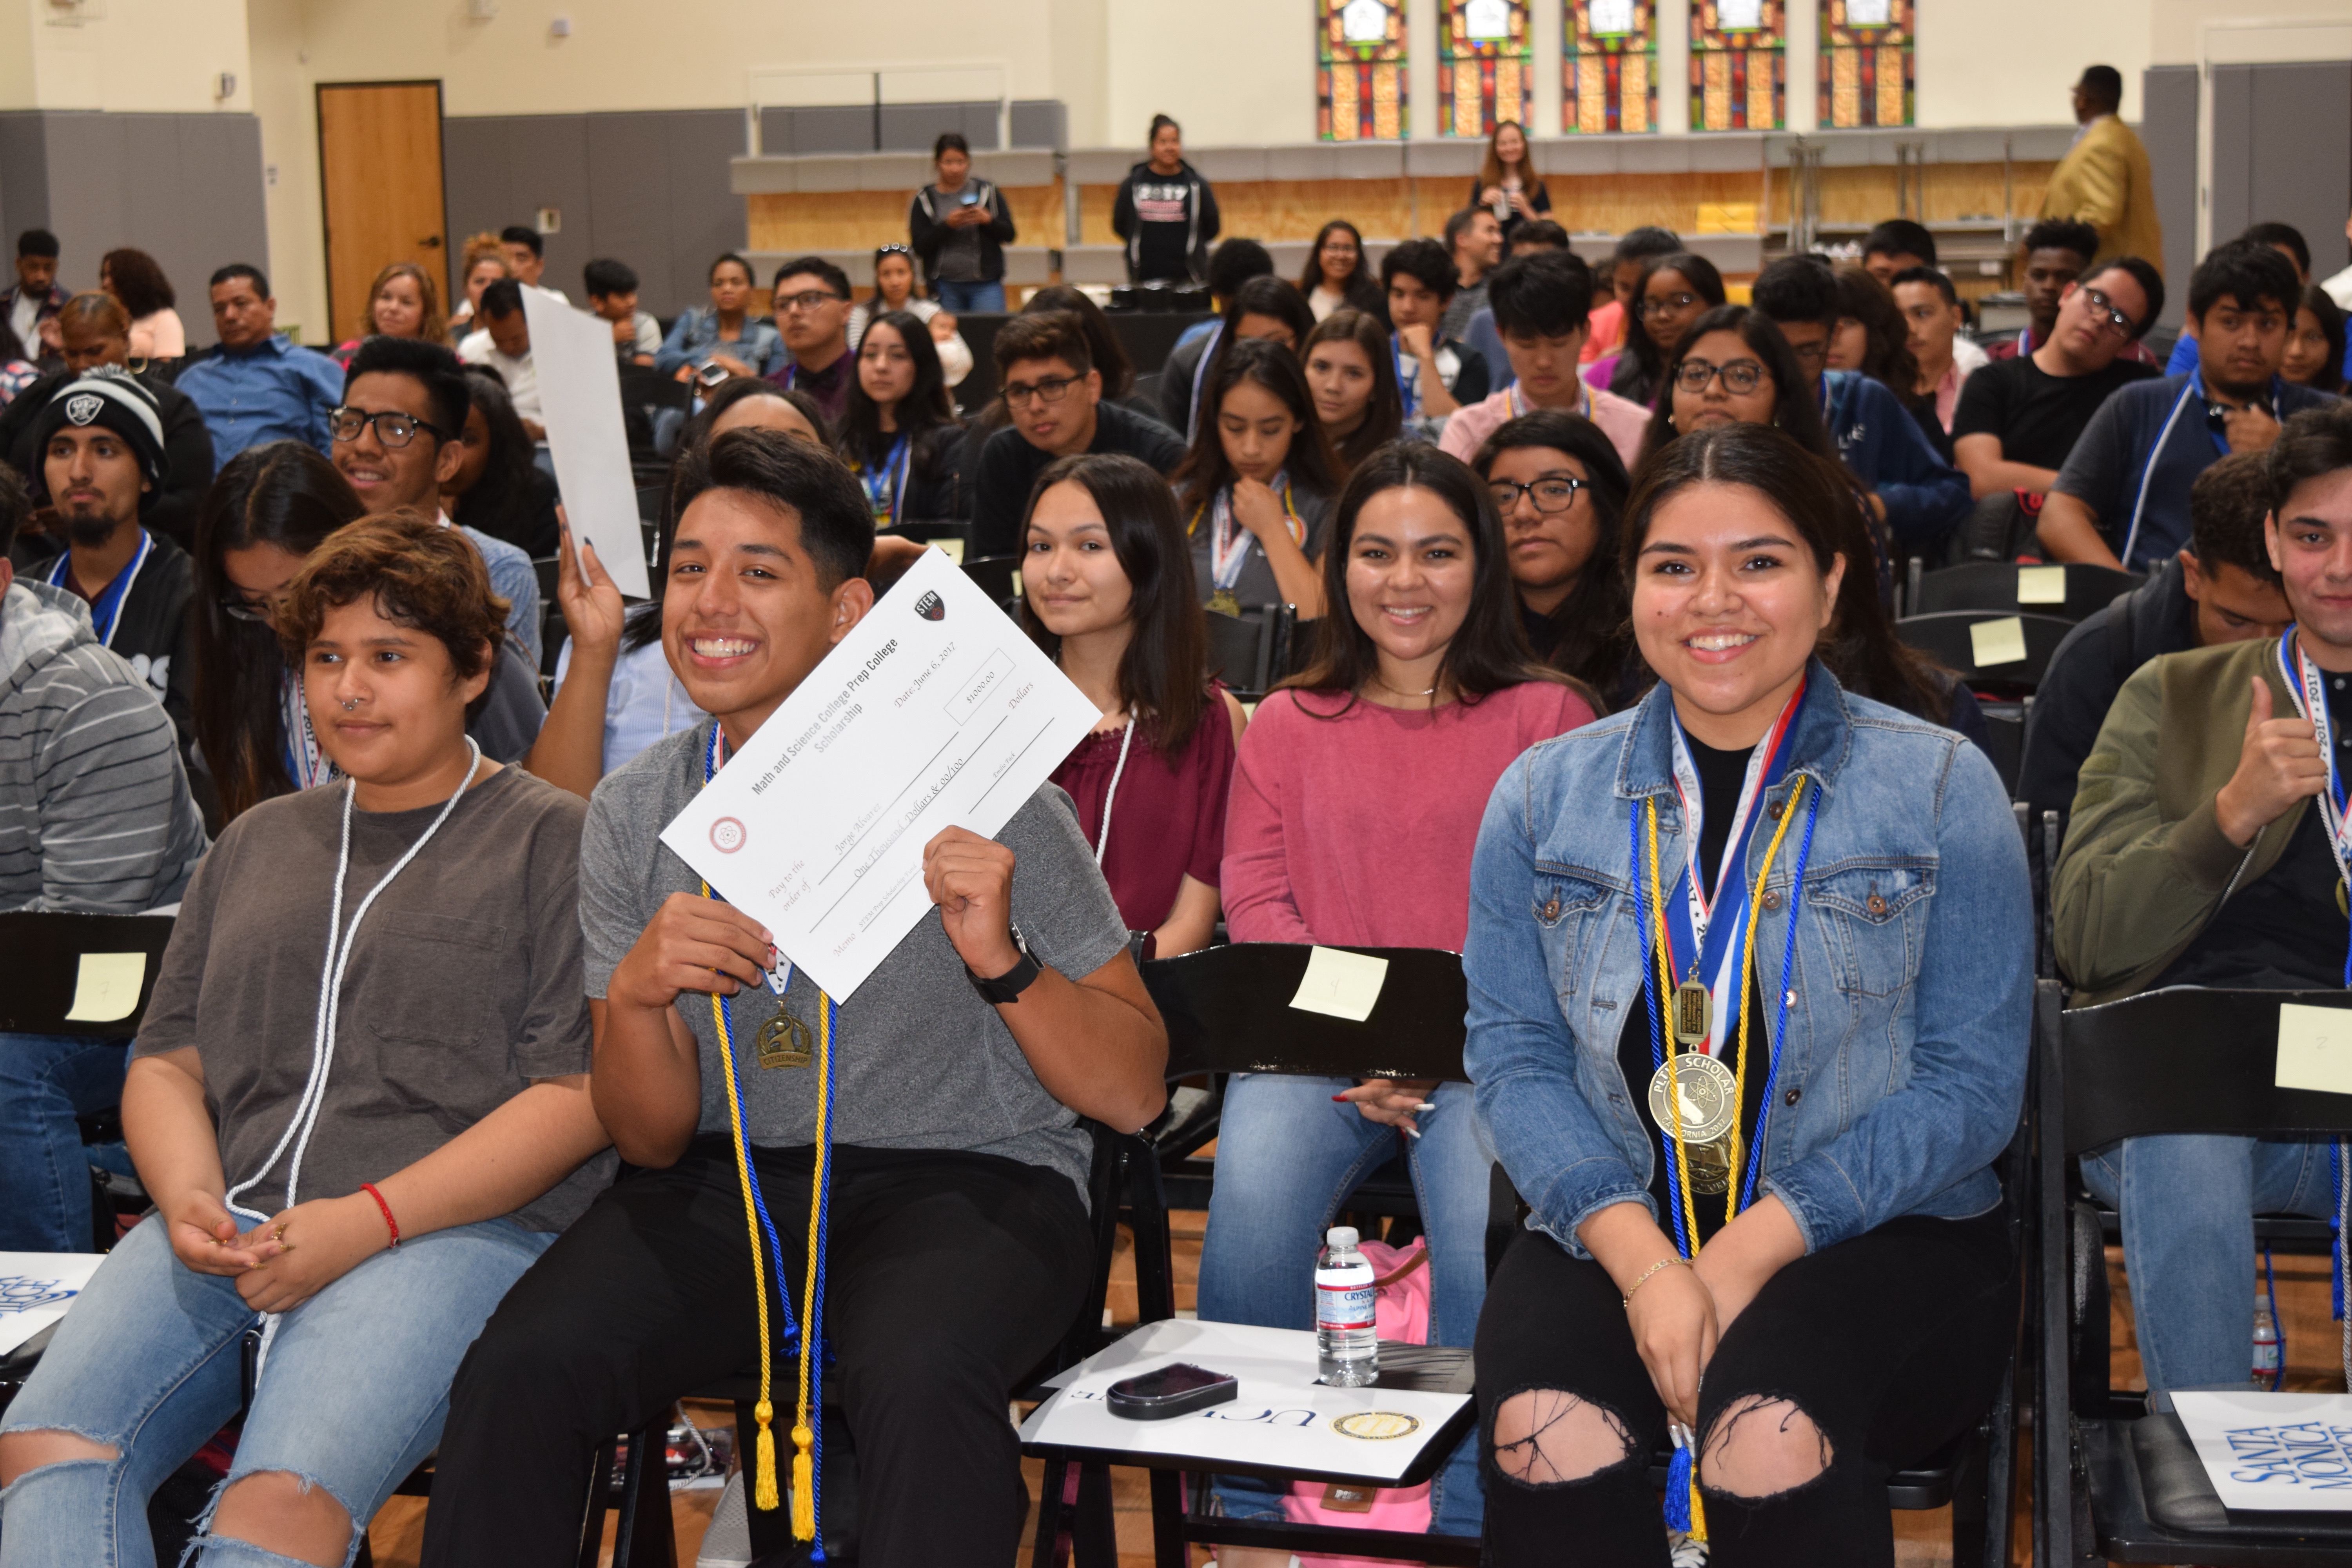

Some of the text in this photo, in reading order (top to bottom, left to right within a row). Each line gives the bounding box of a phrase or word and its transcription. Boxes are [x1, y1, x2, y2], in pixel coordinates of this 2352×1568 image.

[916, 592, 938, 614] STEM
[894, 641, 956, 708] Date: June 6, 2017
[966, 671, 995, 704] $1000.00
[1008, 682, 1034, 710] Dollars
[2307, 674, 2327, 747] 2017 2017
[751, 638, 898, 795] Math and Science College Prep College
[814, 702, 862, 753] Scholarship
[993, 763, 1006, 778] Emilio
[835, 803, 882, 855] Jorge Alvarez
[854, 759, 963, 878] One Thousand Dollars & 00/100
[769, 860, 805, 898] Pay to the
[783, 877, 811, 911] order of
[859, 910, 874, 927] STEM
[873, 900, 884, 911] Prep
[882, 876, 905, 901] Scholarship
[833, 933, 856, 956] Memo
[763, 1054, 808, 1065] CITIZENSHIP
[1685, 1057, 1735, 1096] SCHOLAR
[1661, 1117, 1726, 1138] CALORNIA 2017
[2222, 1426, 2299, 1484] SANTA
[2274, 1420, 2352, 1490] MONICA
